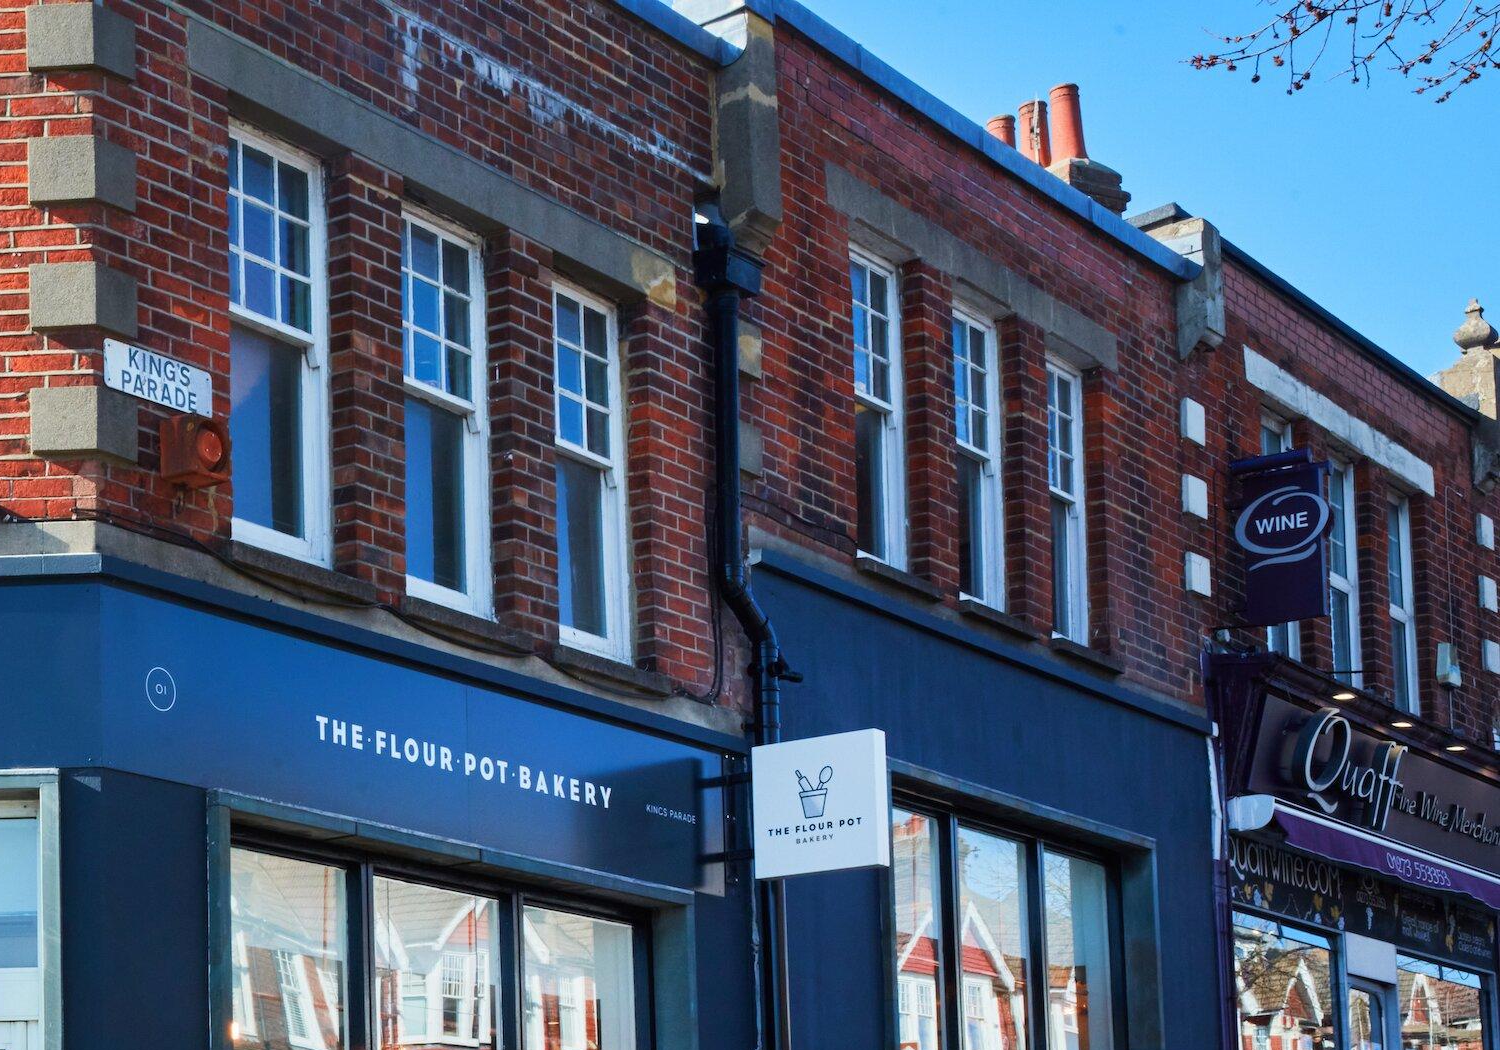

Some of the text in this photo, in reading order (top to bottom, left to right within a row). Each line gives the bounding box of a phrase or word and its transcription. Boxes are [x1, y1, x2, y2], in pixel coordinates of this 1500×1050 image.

[128, 347, 191, 387] KING'S
[121, 369, 198, 414] PARADE
[1255, 511, 1309, 535] WINE
[315, 714, 612, 809] THE FLOUR POT BAKERY
[1304, 707, 1408, 832] Quaff
[669, 809, 696, 825] PARADE
[1421, 791, 1449, 827] Wine
[768, 816, 862, 836] THE FLOUR POT
[795, 833, 834, 845] BAKERY
[1413, 861, 1452, 887] 553353
